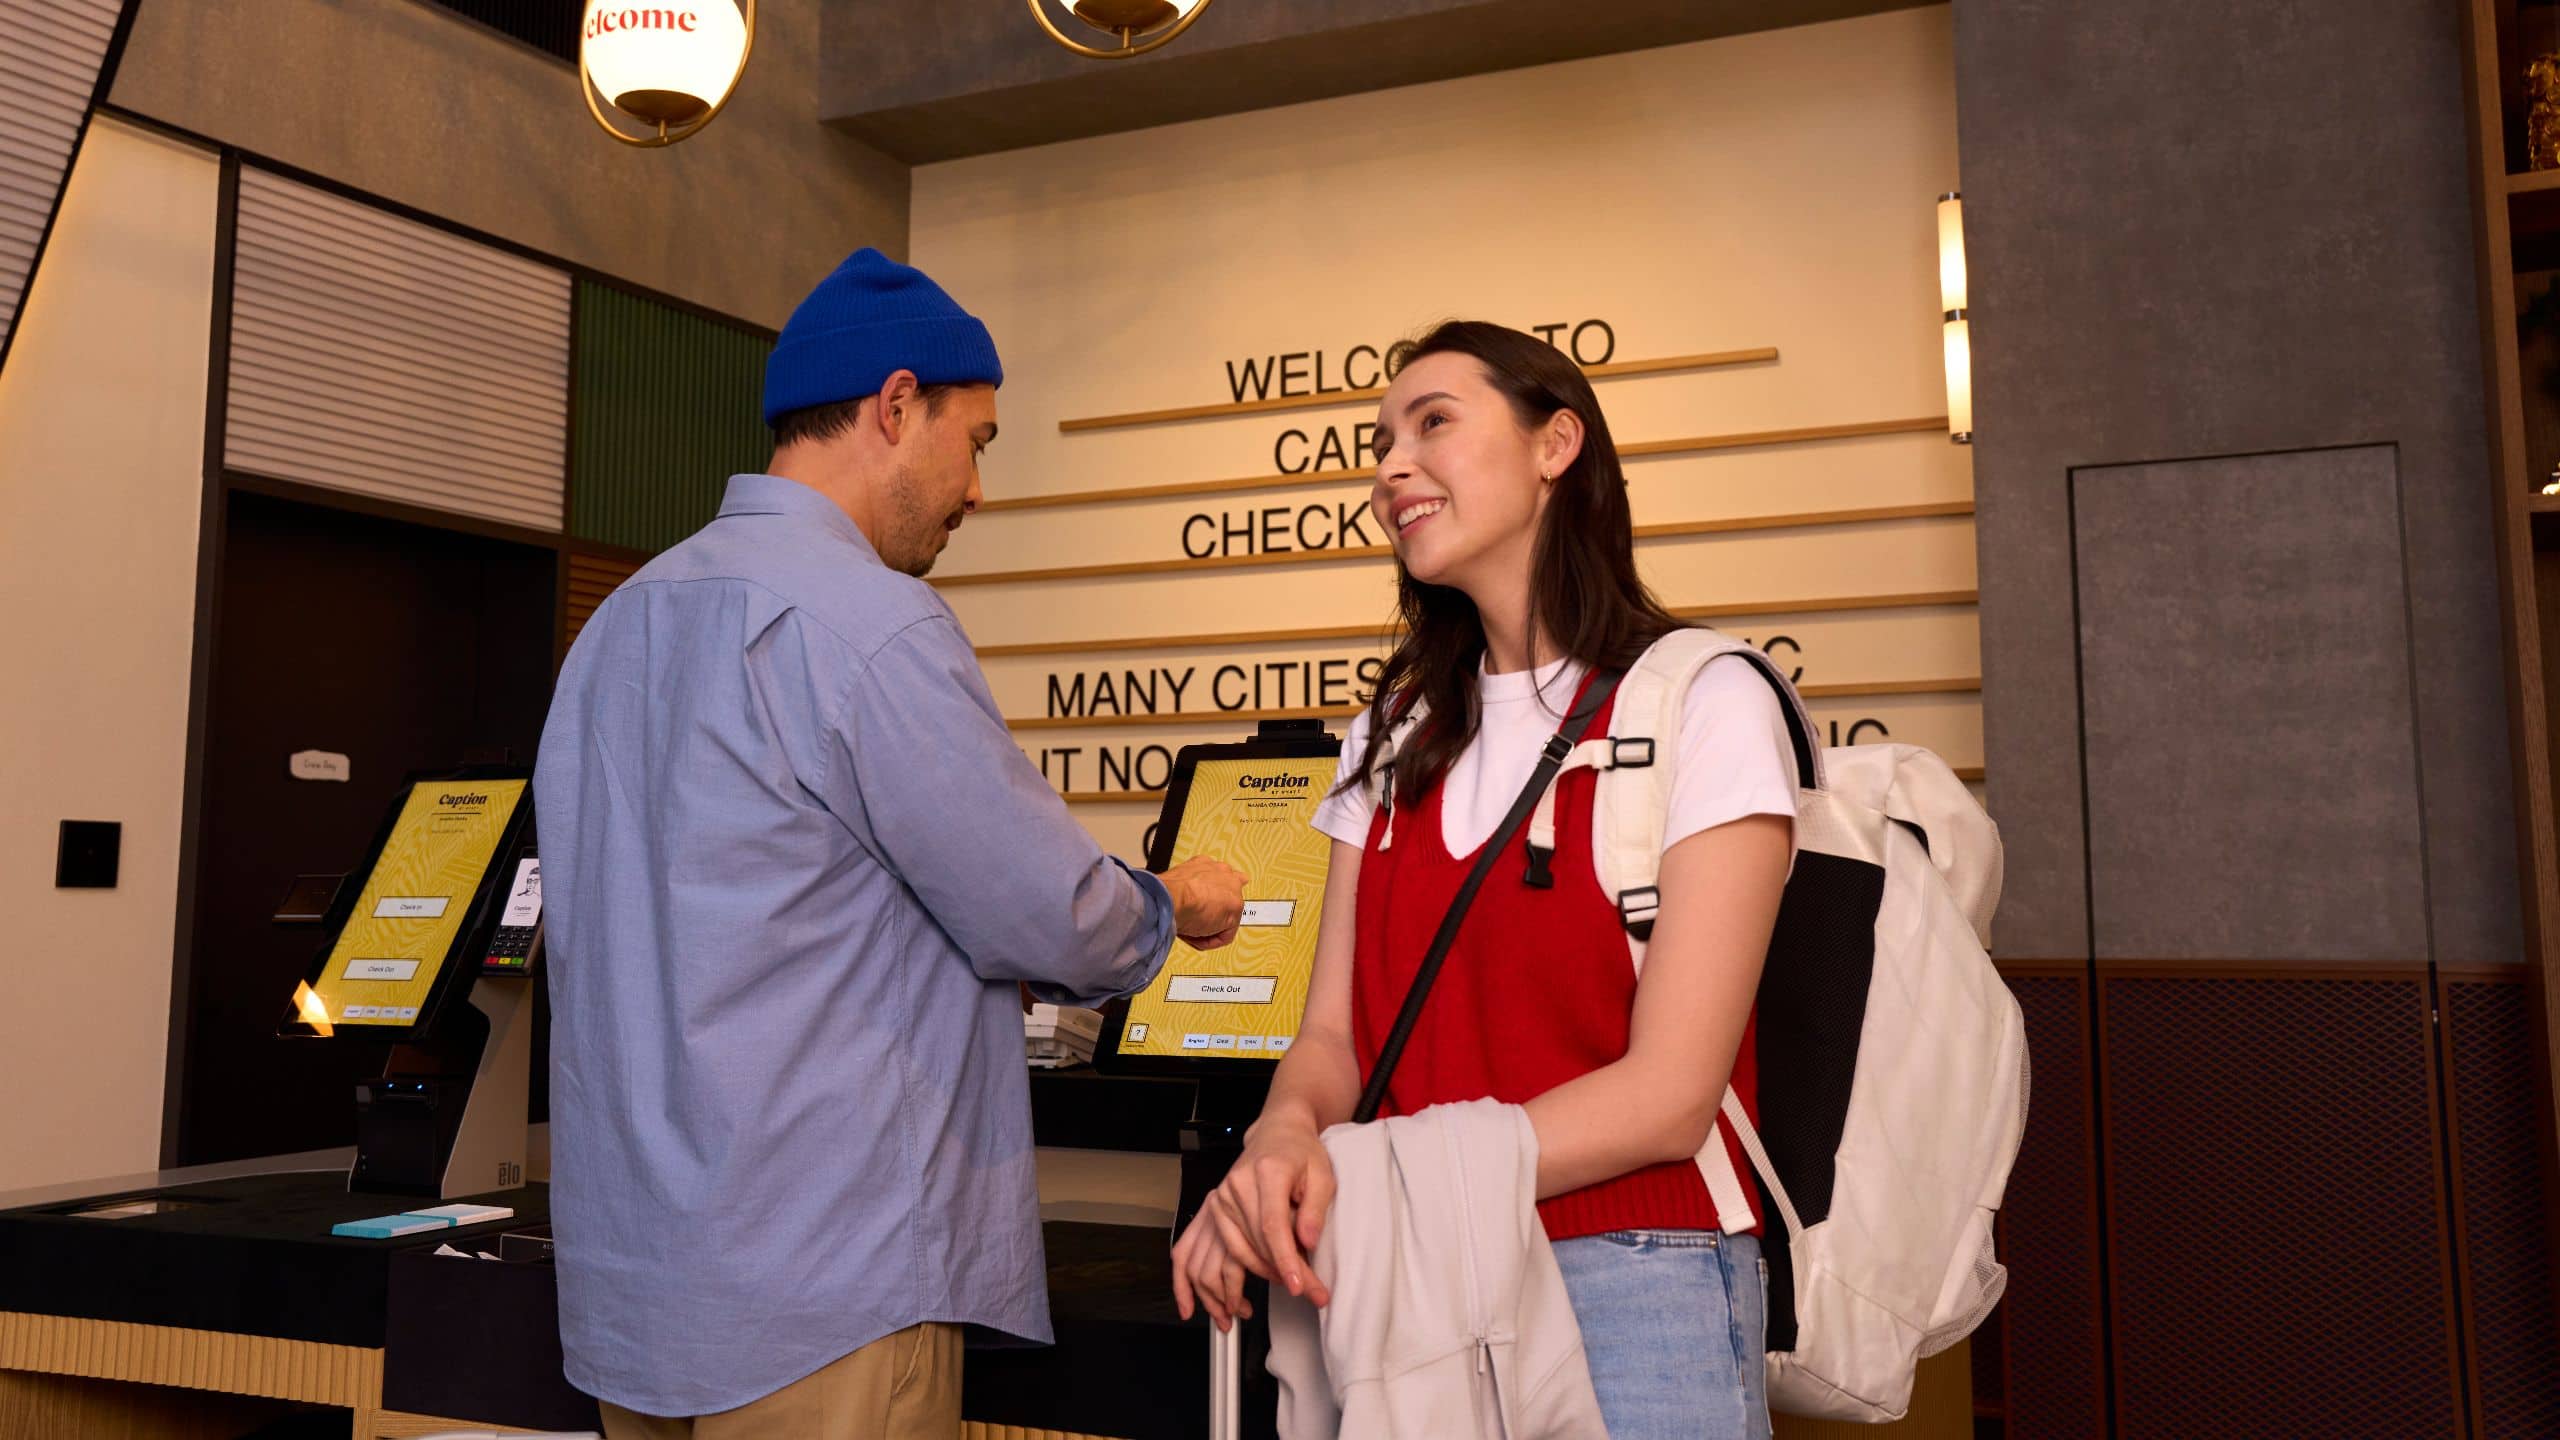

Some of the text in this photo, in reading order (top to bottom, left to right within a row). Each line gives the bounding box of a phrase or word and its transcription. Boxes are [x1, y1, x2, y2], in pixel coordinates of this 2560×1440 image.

[587, 9, 697, 39] elcome
[1532, 318, 1615, 367] TO
[1182, 500, 1371, 559] CHECK
[1048, 656, 1384, 718] MANY CITIES
[1238, 772, 1309, 792] Caption
[439, 792, 488, 809] Caption
[1201, 985, 1241, 993] Check Out
